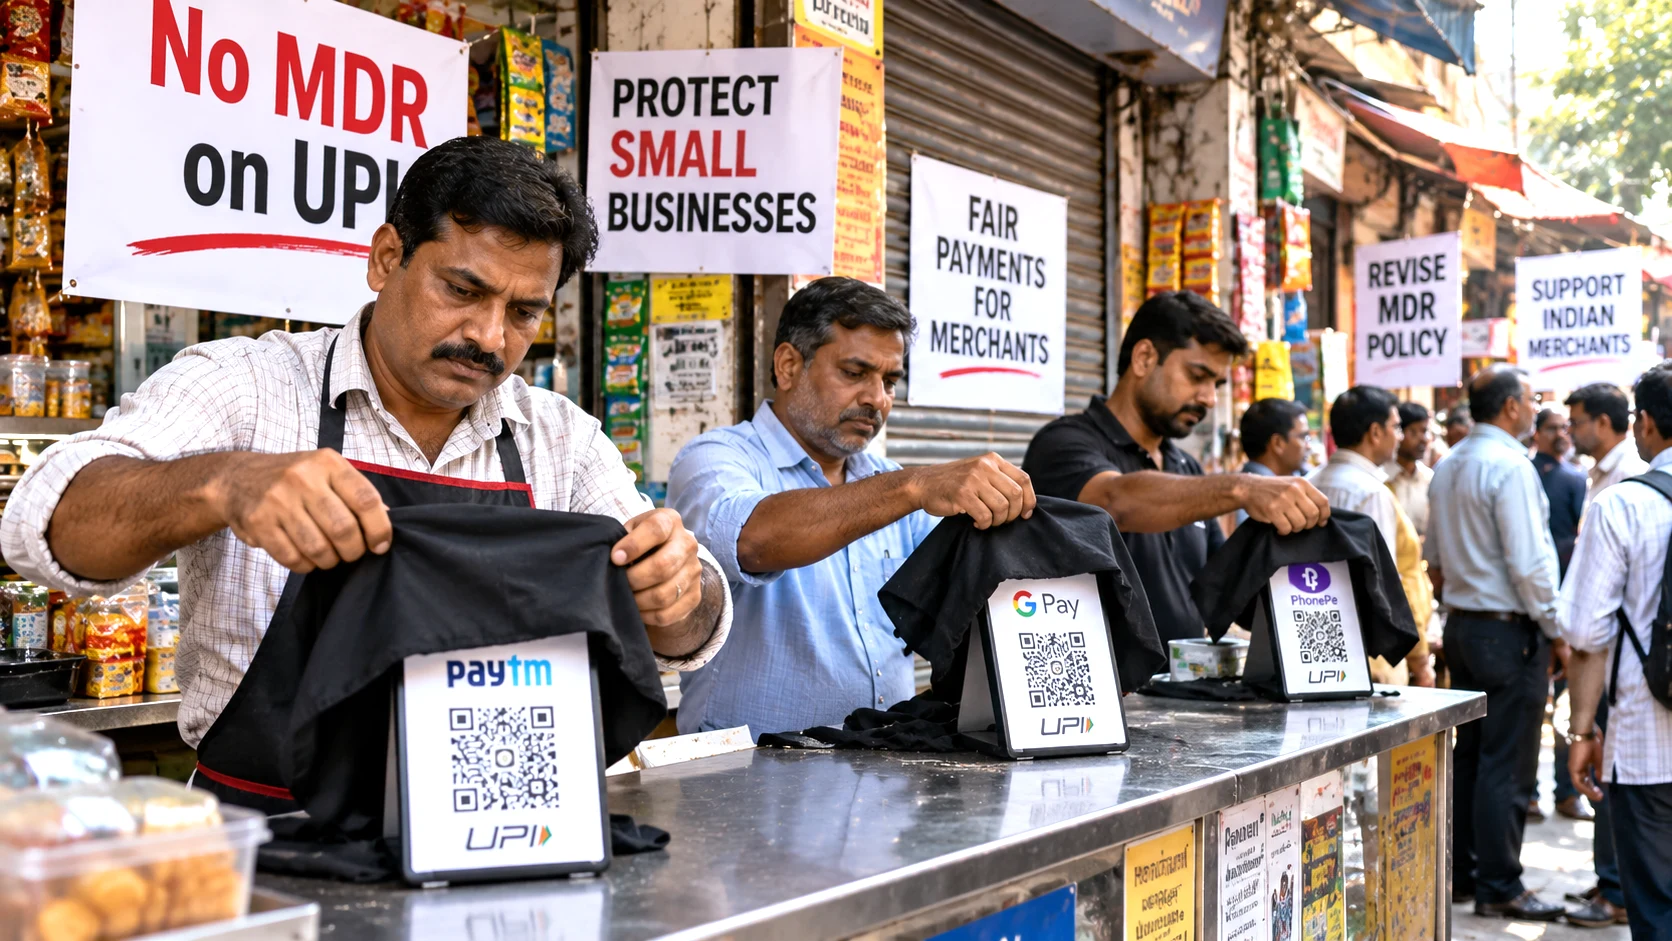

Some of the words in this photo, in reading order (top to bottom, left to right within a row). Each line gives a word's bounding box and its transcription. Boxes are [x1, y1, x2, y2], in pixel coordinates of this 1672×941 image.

[150, 0, 249, 104] No
[274, 31, 429, 149] MDR
[612, 75, 779, 118] PROTECT
[609, 129, 757, 178] SMALL
[183, 142, 269, 215] on
[293, 138, 399, 230] UPI
[607, 192, 817, 234] BUSINESSES
[969, 195, 1018, 242] FAIR
[936, 235, 1046, 289] PAYMENTS
[1368, 254, 1446, 288] REVISE
[974, 286, 1012, 322] FOR
[1532, 274, 1625, 302] SUPPORT
[1378, 292, 1436, 324] MDR
[1542, 304, 1614, 330] INDIAN
[930, 319, 1050, 365] MERCHANTS
[1366, 327, 1448, 360] POLICY
[1528, 333, 1631, 359] MERCHANTS
[1012, 590, 1037, 618] G
[1041, 593, 1080, 620] Pay
[1290, 594, 1338, 606] PhonePe
[446, 654, 553, 688] paytm
[1309, 670, 1341, 684] UPI
[1041, 716, 1085, 736] UPI
[465, 824, 538, 851] UPI
